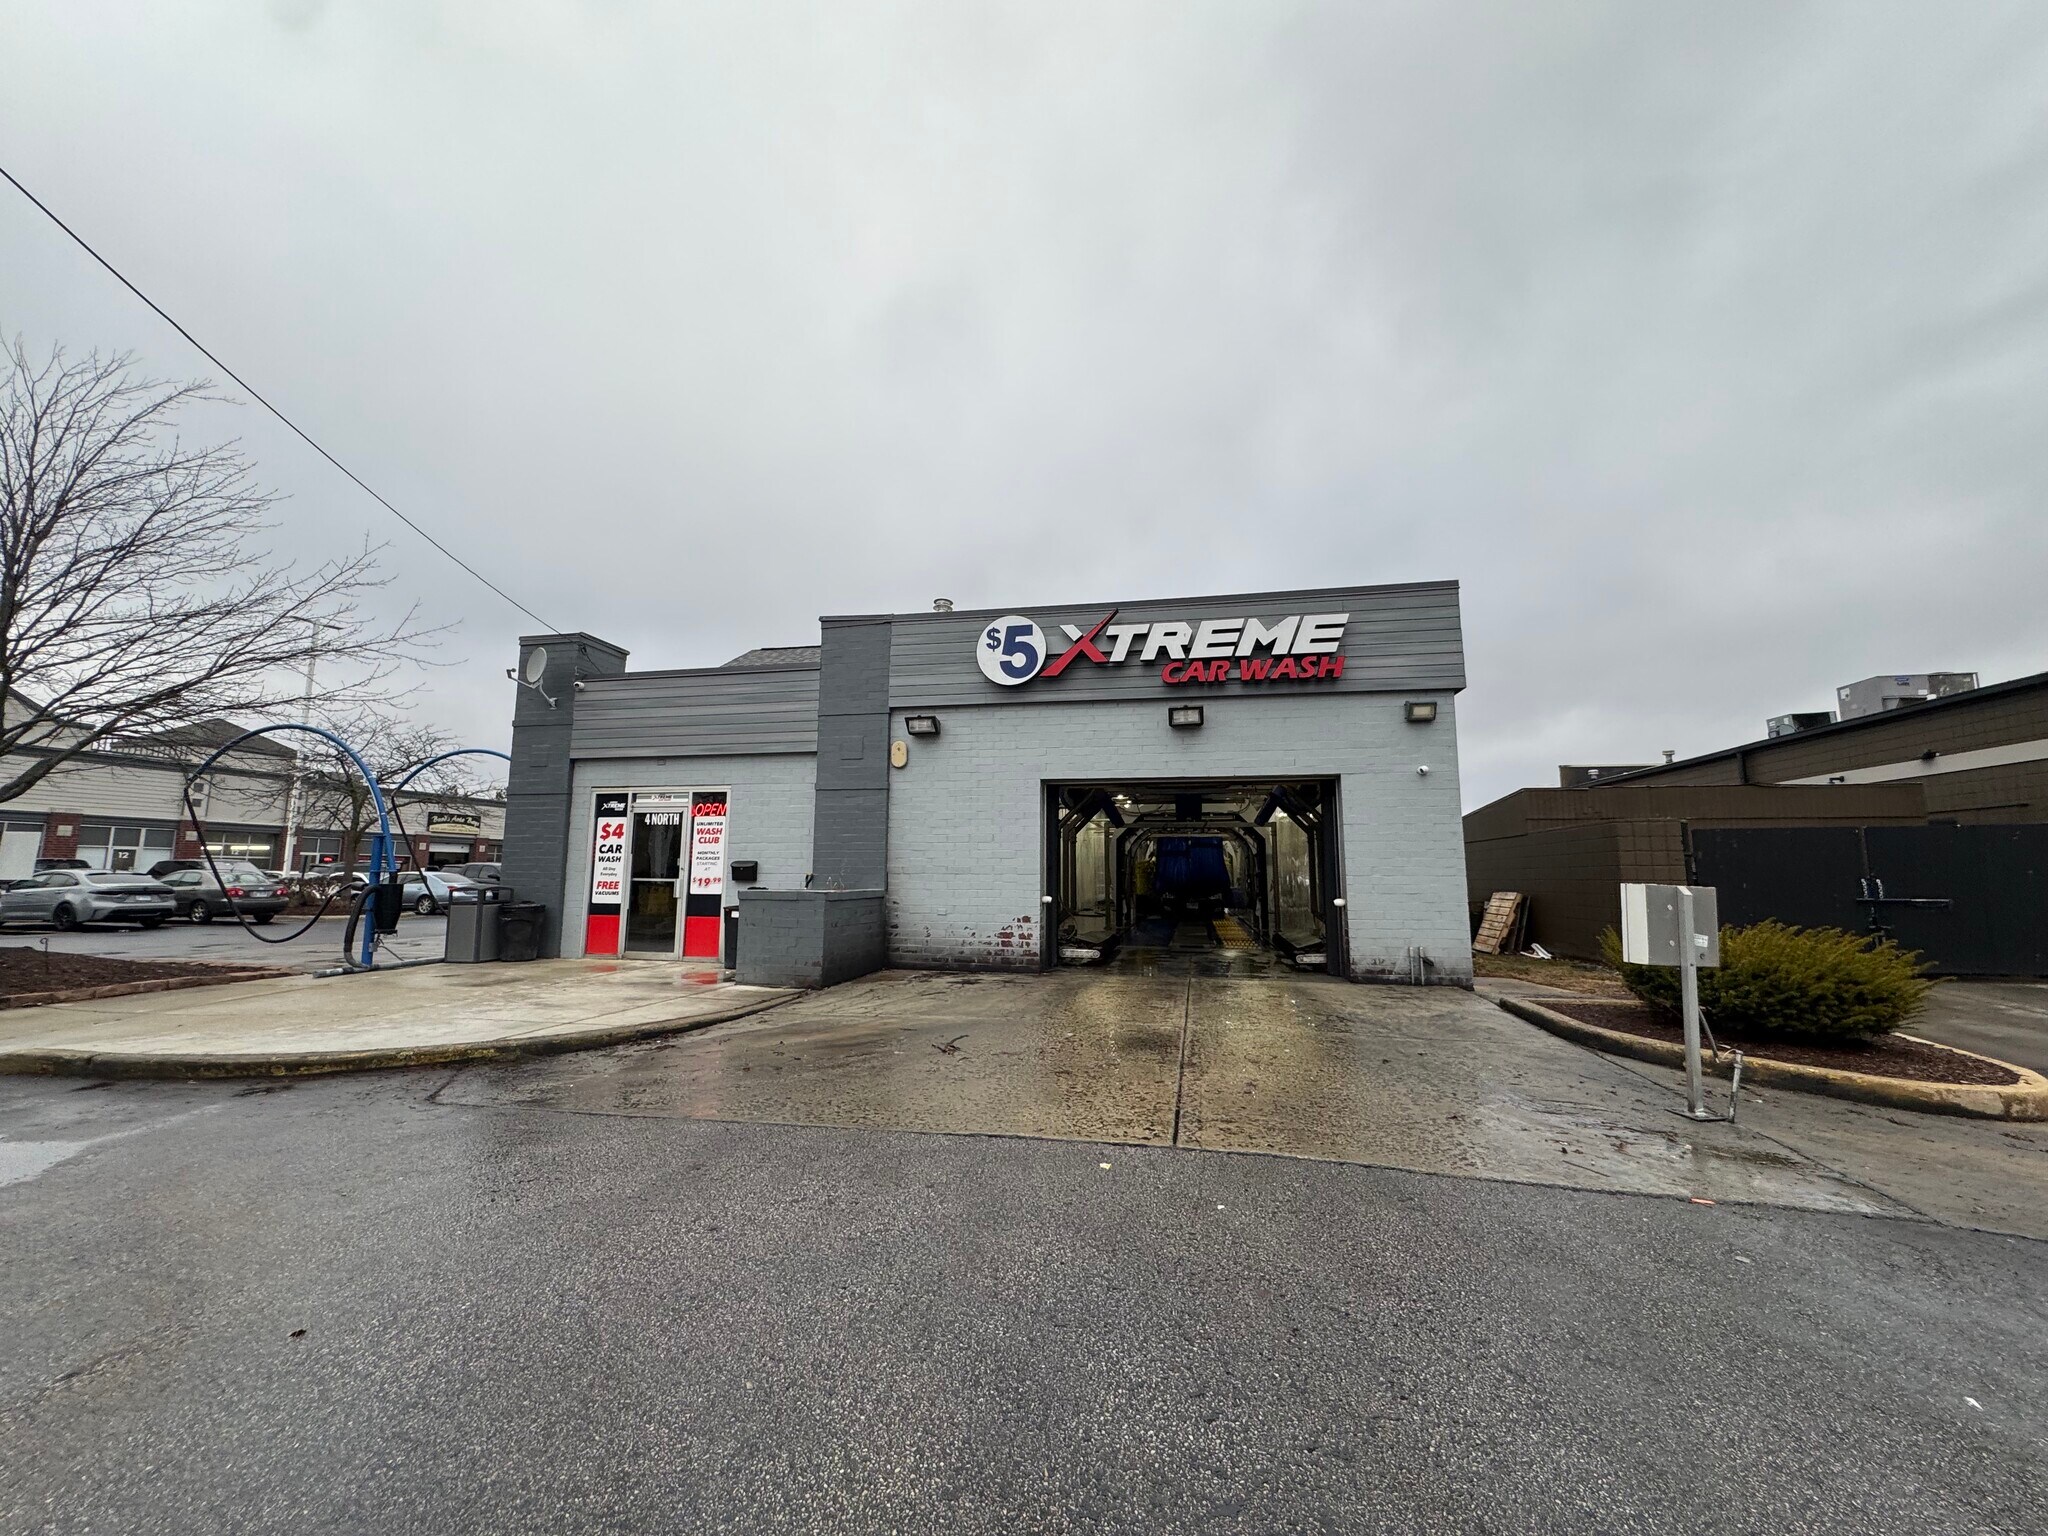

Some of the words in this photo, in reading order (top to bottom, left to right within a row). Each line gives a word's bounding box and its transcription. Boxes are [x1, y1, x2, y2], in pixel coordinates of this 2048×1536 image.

[986, 624, 1038, 679] $5
[1040, 608, 1350, 678] XTREME
[1161, 660, 1231, 685] CAR
[1239, 656, 1346, 681] WASH
[601, 803, 626, 811] XTREME
[695, 803, 728, 817] OPEN
[644, 813, 651, 825] 4
[651, 813, 680, 825] NORTH
[600, 822, 625, 841] $4
[696, 827, 723, 836] WASH
[698, 836, 720, 844] CLUB
[599, 844, 623, 854] CAR
[118, 851, 129, 859] 12
[596, 881, 620, 890] FREE
